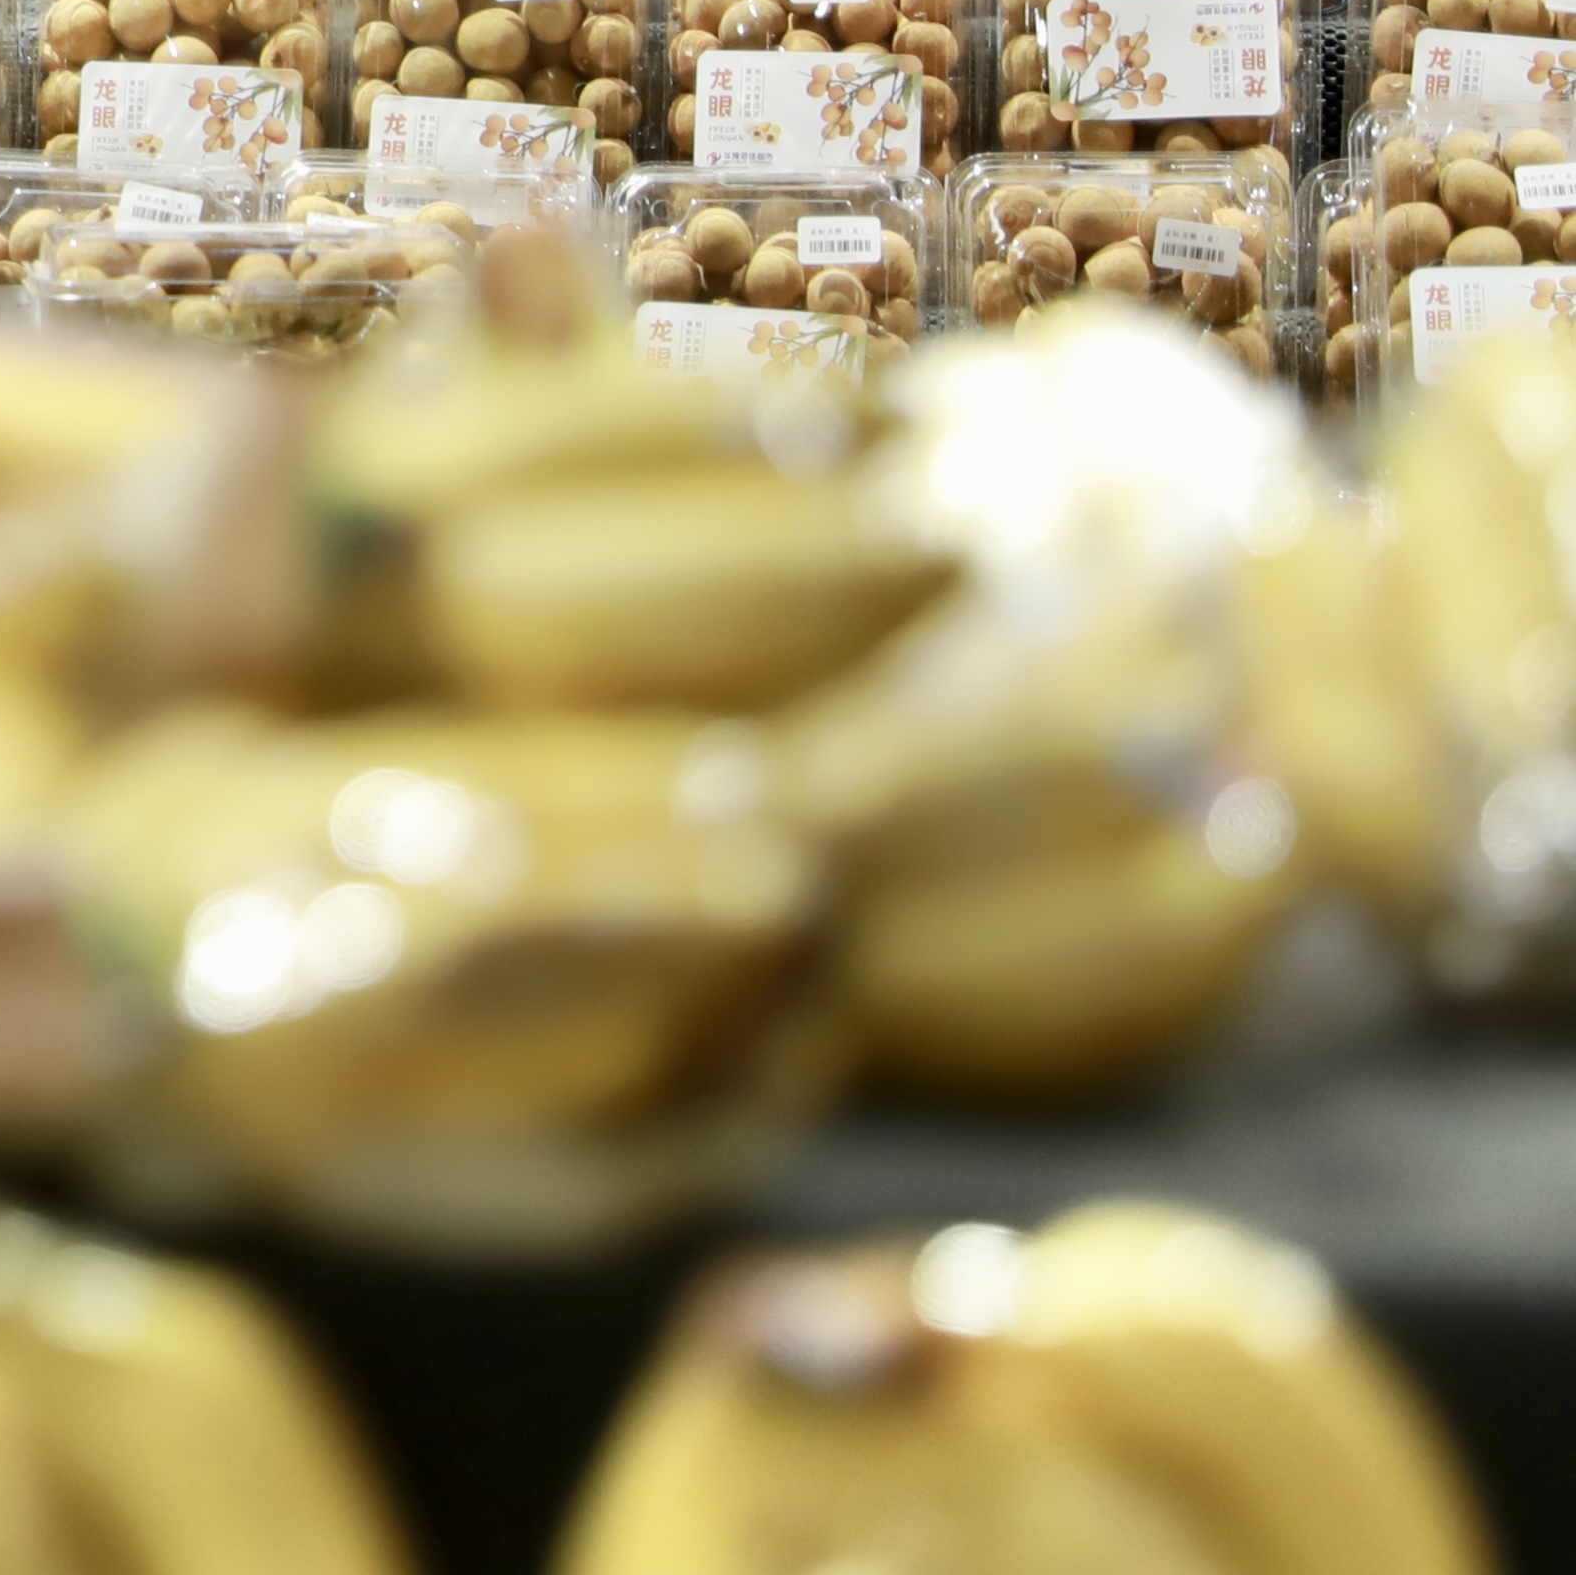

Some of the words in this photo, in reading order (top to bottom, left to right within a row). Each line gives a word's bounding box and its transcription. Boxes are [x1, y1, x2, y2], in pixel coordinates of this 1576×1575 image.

[708, 68, 733, 118] 龙眼
[1241, 47, 1268, 97] 龙眼
[92, 79, 117, 128] 龙眼
[1425, 284, 1453, 332] 龙眼
[647, 319, 673, 369] 龙眼
